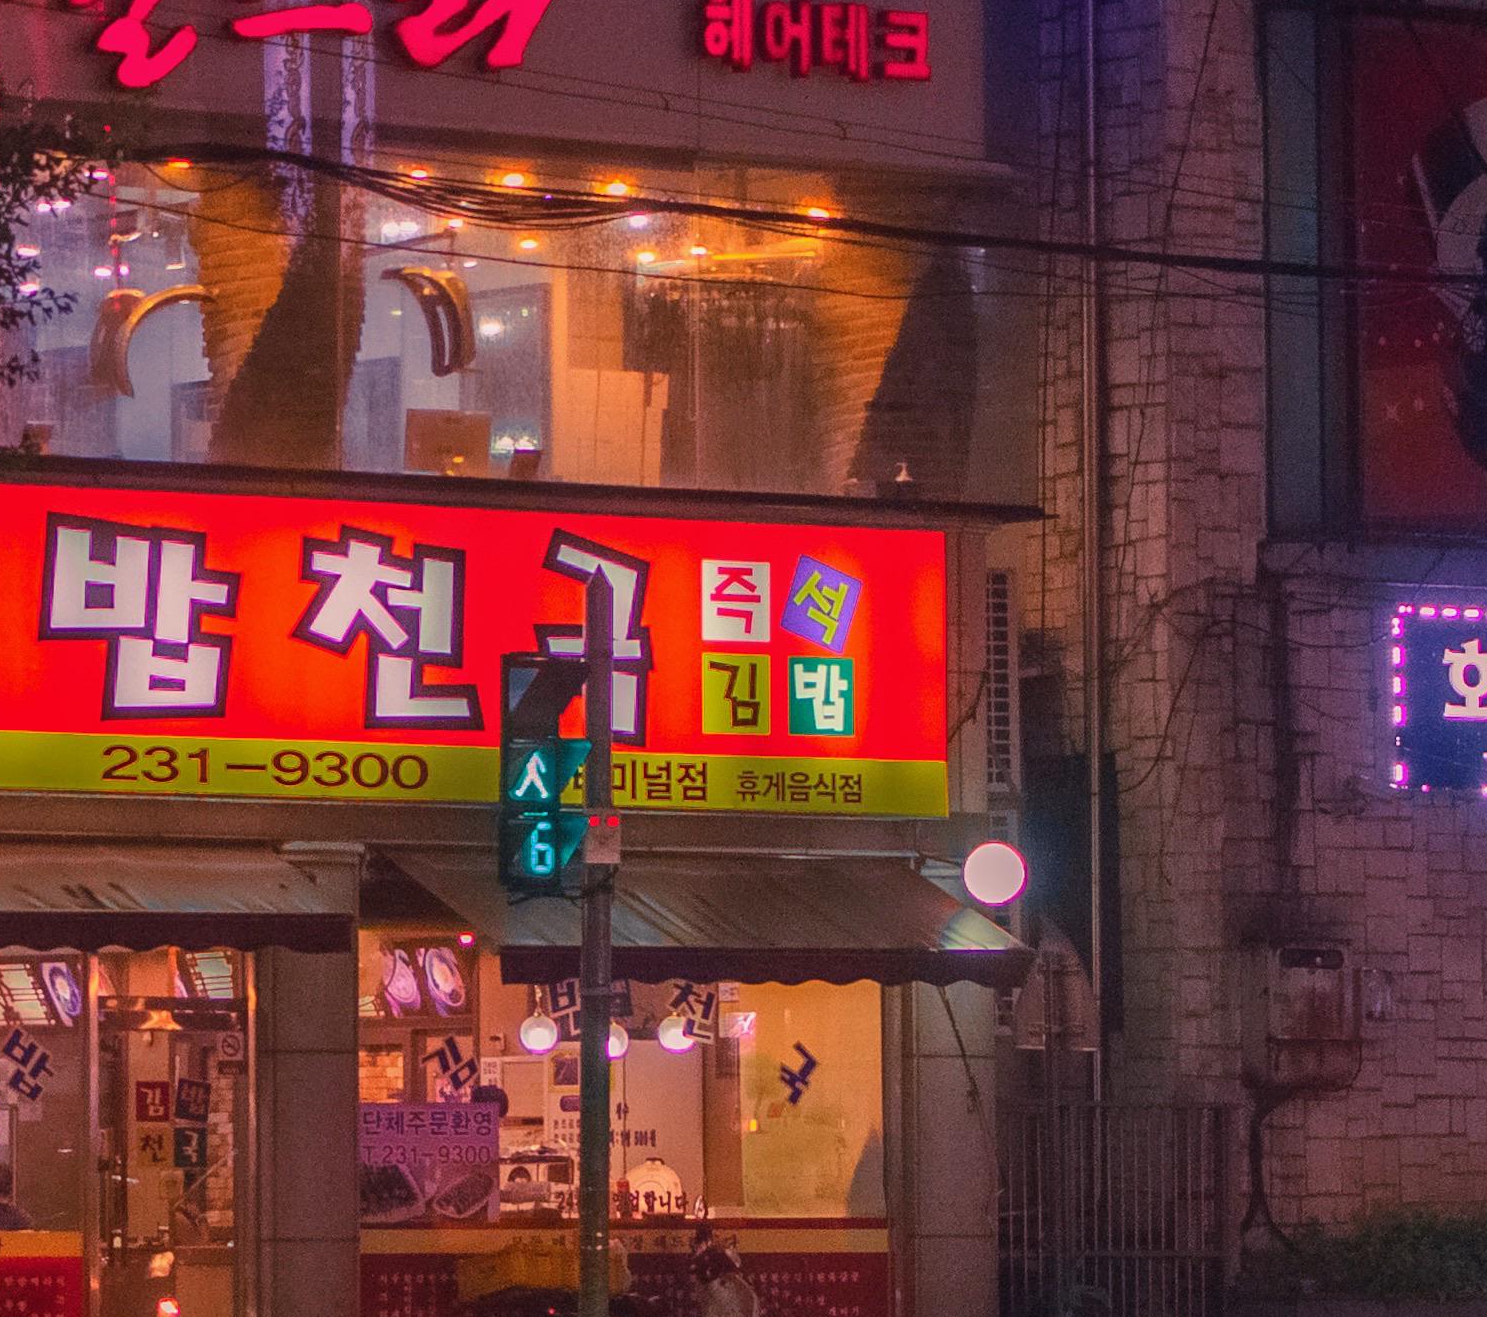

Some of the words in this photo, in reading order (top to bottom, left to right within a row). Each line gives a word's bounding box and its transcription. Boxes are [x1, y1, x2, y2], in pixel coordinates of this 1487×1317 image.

[707, 660, 848, 733] 김밥
[100, 742, 429, 792] 231-9300
[734, 771, 864, 805] 휴게음식점
[530, 822, 555, 875] 6
[361, 1109, 493, 1138] 단체주문환영
[361, 1144, 492, 1166] T.231-9300
